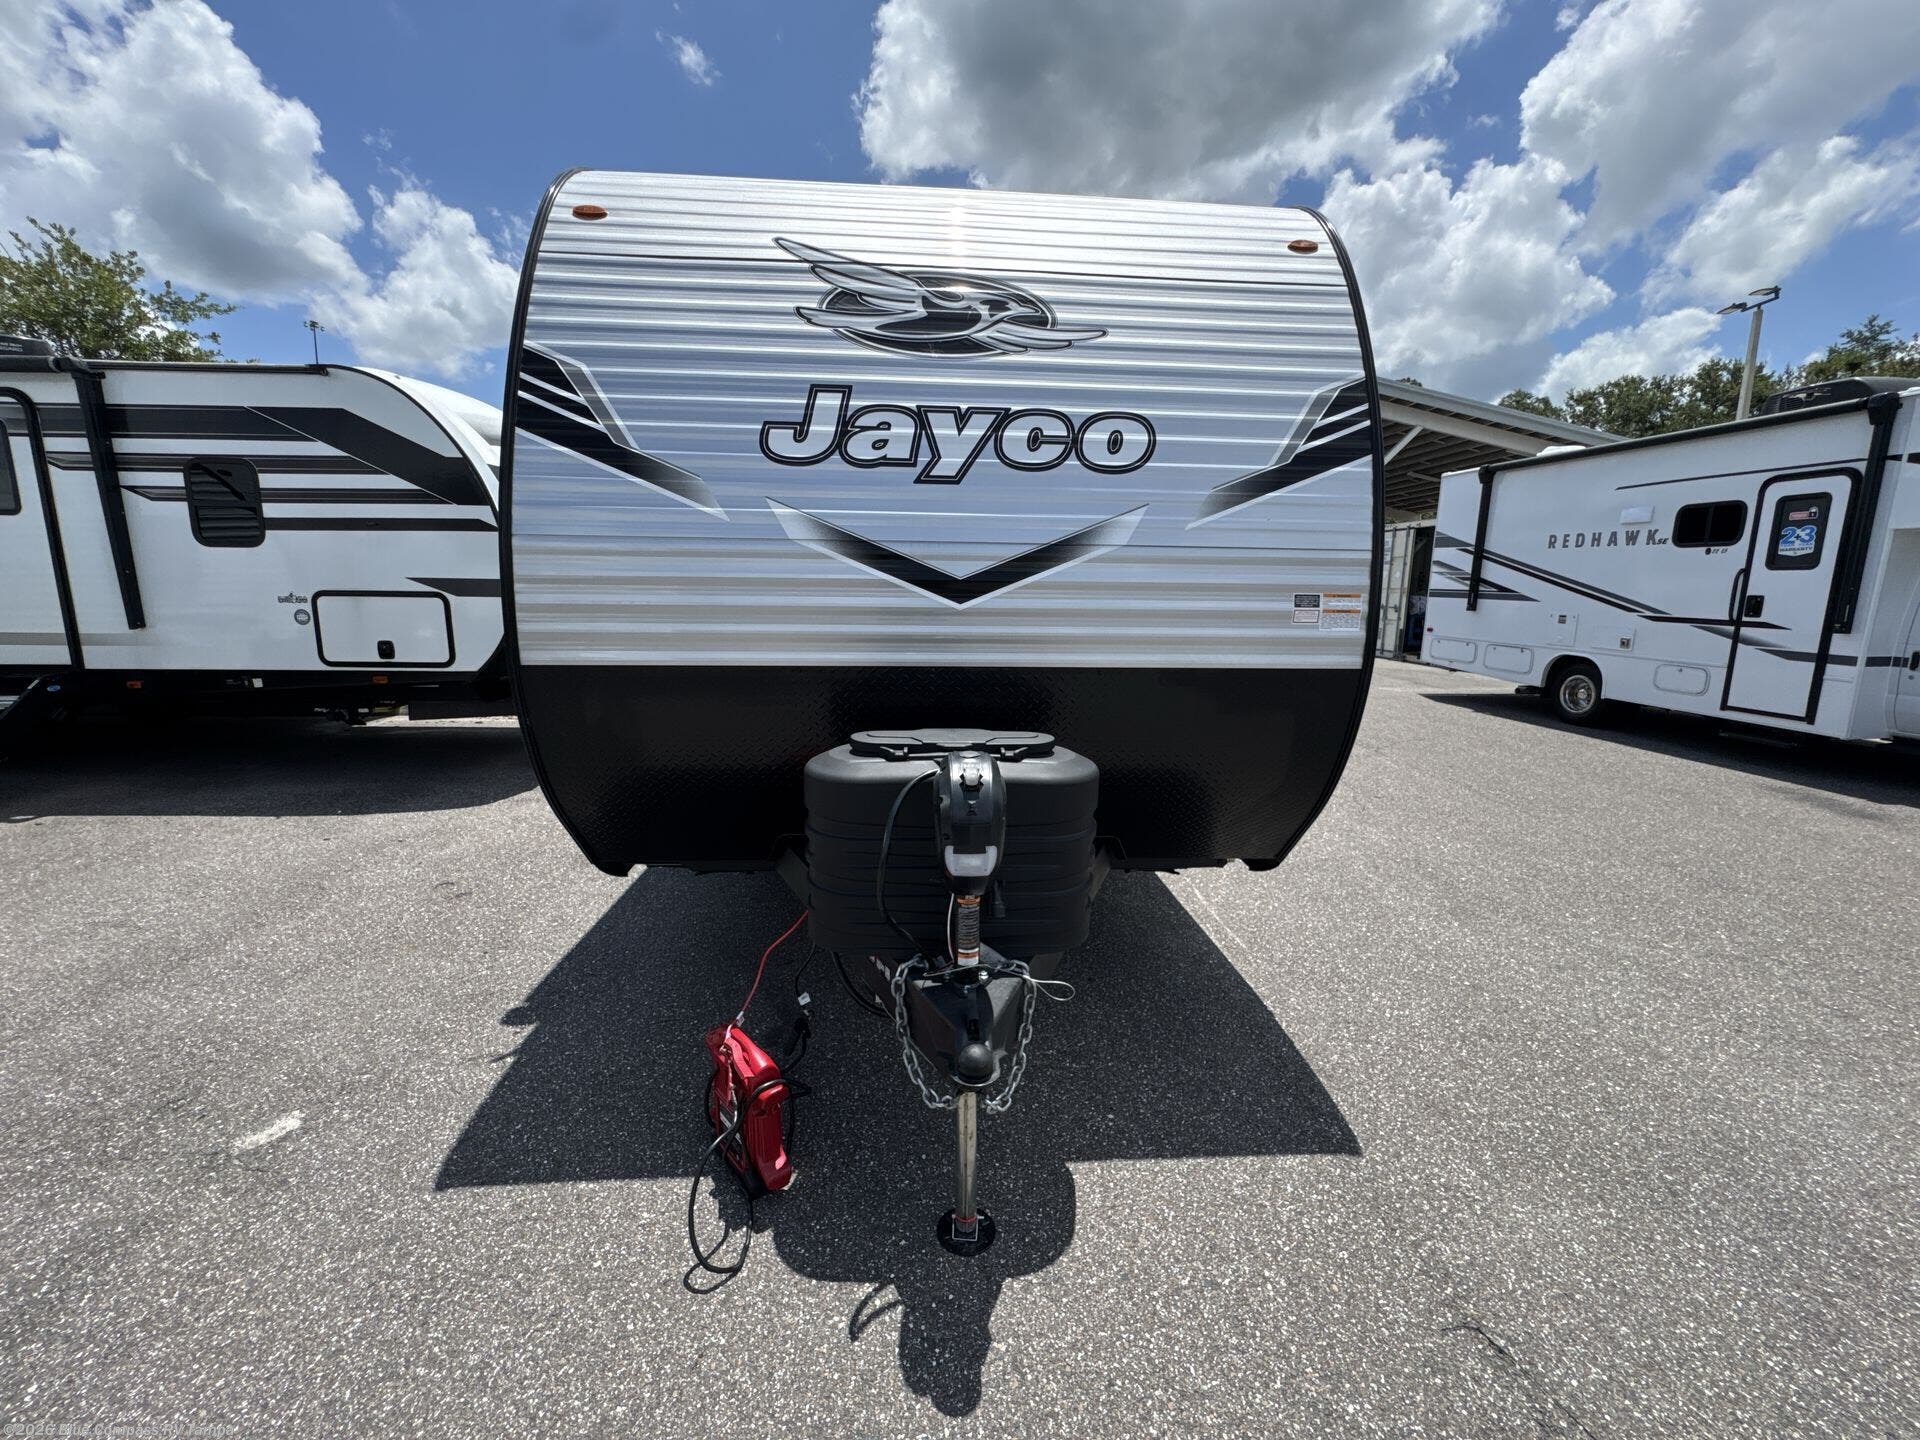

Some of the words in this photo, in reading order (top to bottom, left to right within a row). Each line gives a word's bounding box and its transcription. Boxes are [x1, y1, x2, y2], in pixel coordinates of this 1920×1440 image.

[759, 383, 1157, 485] Jayco
[1548, 529, 1659, 549] REDHAWK
[1657, 537, 1669, 545] SE
